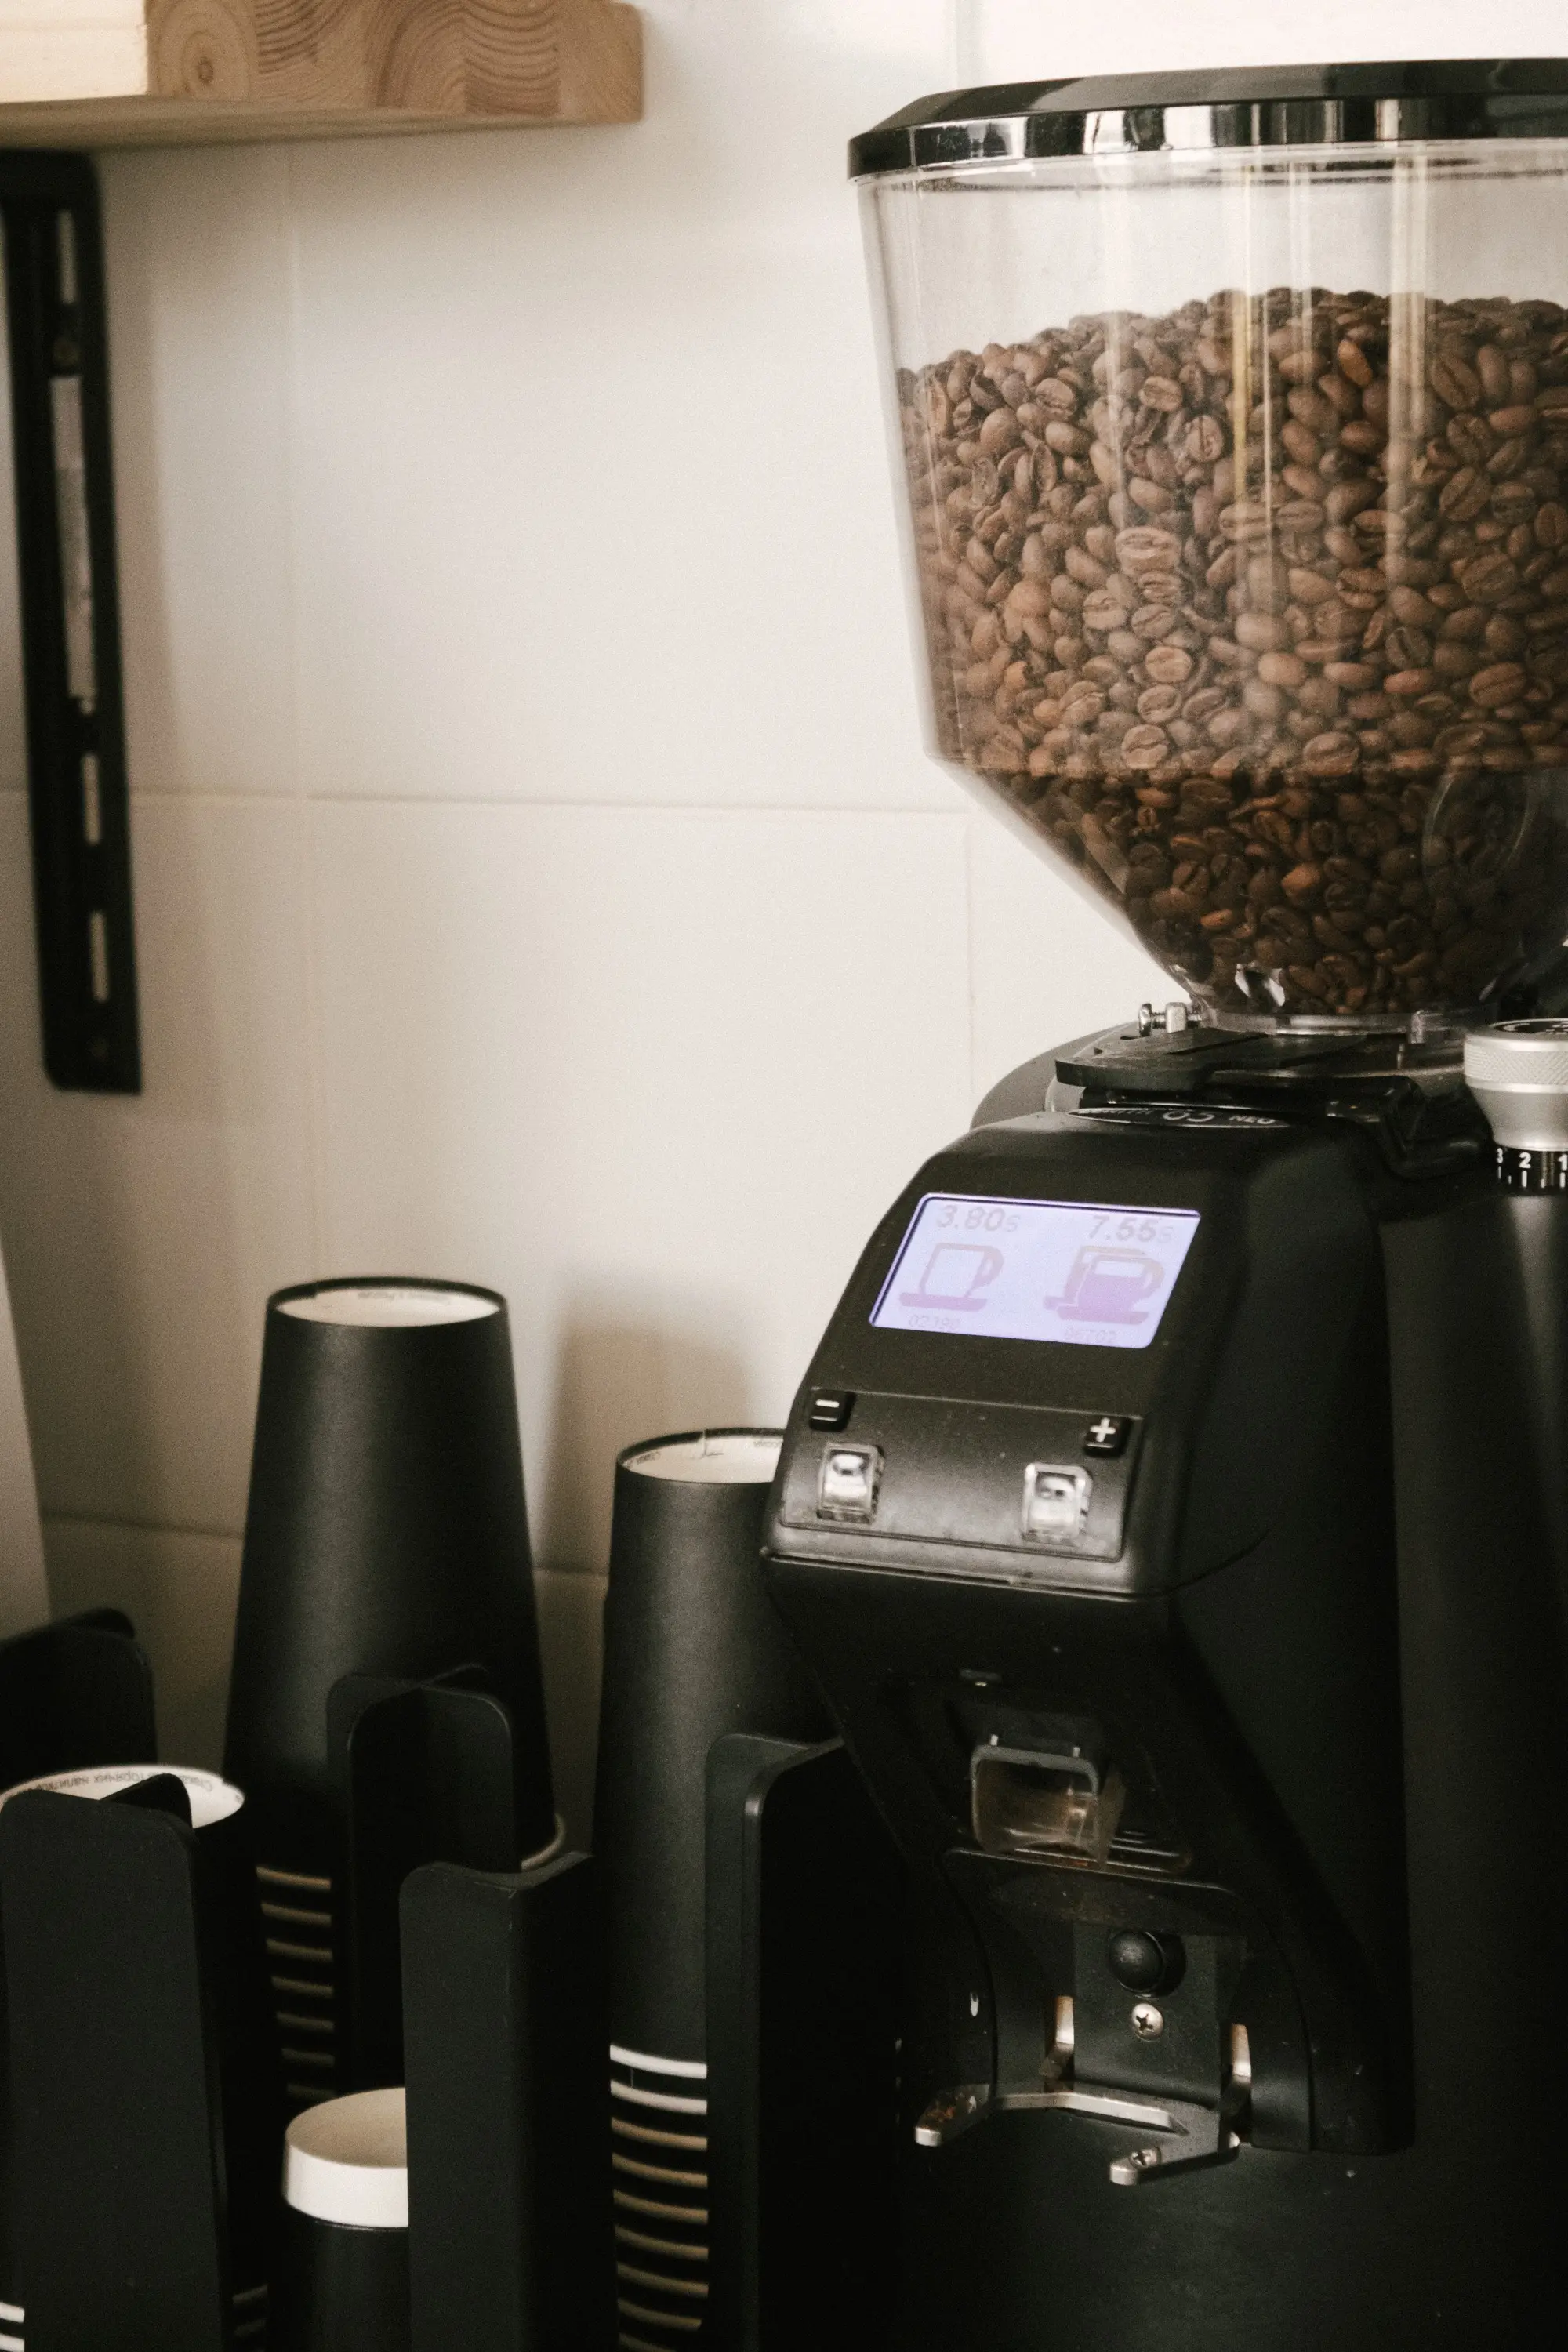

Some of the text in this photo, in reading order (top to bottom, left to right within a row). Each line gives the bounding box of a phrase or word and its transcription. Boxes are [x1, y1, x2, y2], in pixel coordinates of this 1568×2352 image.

[1497, 1147, 1568, 1171] 3 2 1
